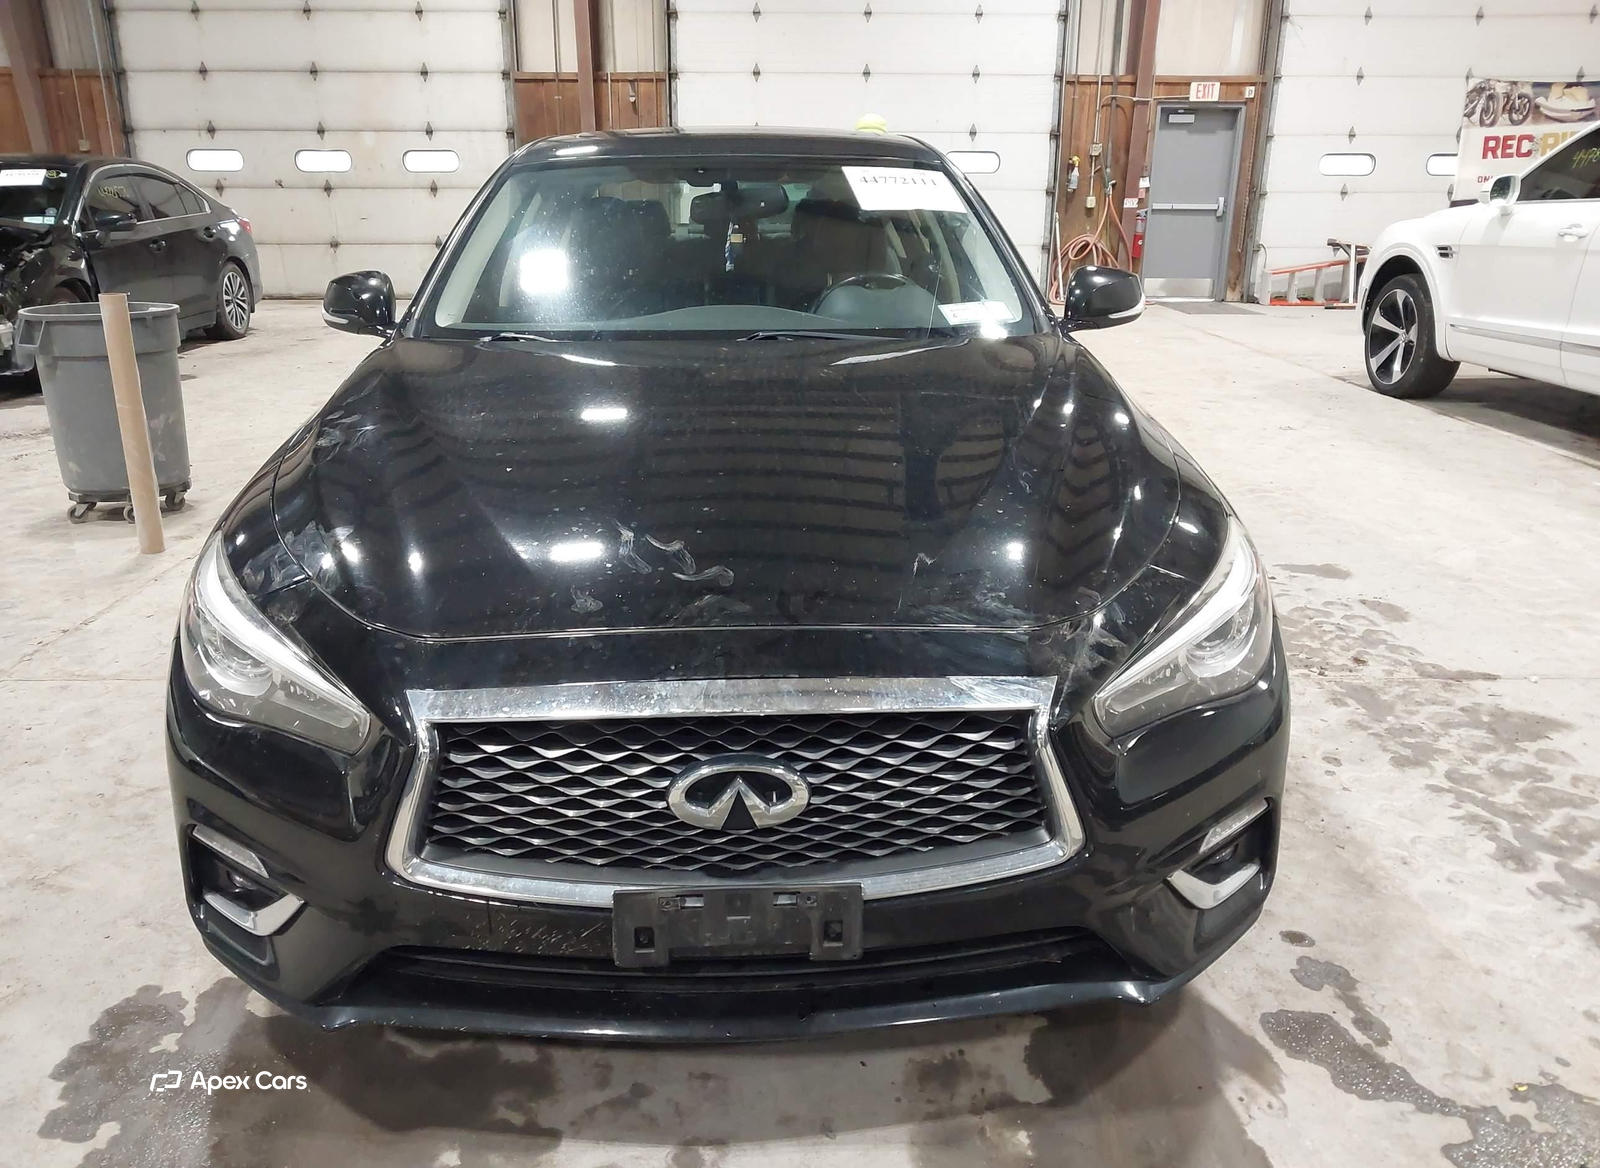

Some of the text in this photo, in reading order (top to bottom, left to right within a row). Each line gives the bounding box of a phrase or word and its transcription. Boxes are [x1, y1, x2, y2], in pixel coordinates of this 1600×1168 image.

[1195, 84, 1216, 99] EXIT
[1482, 134, 1536, 159] REC
[859, 176, 937, 186] 44772111
